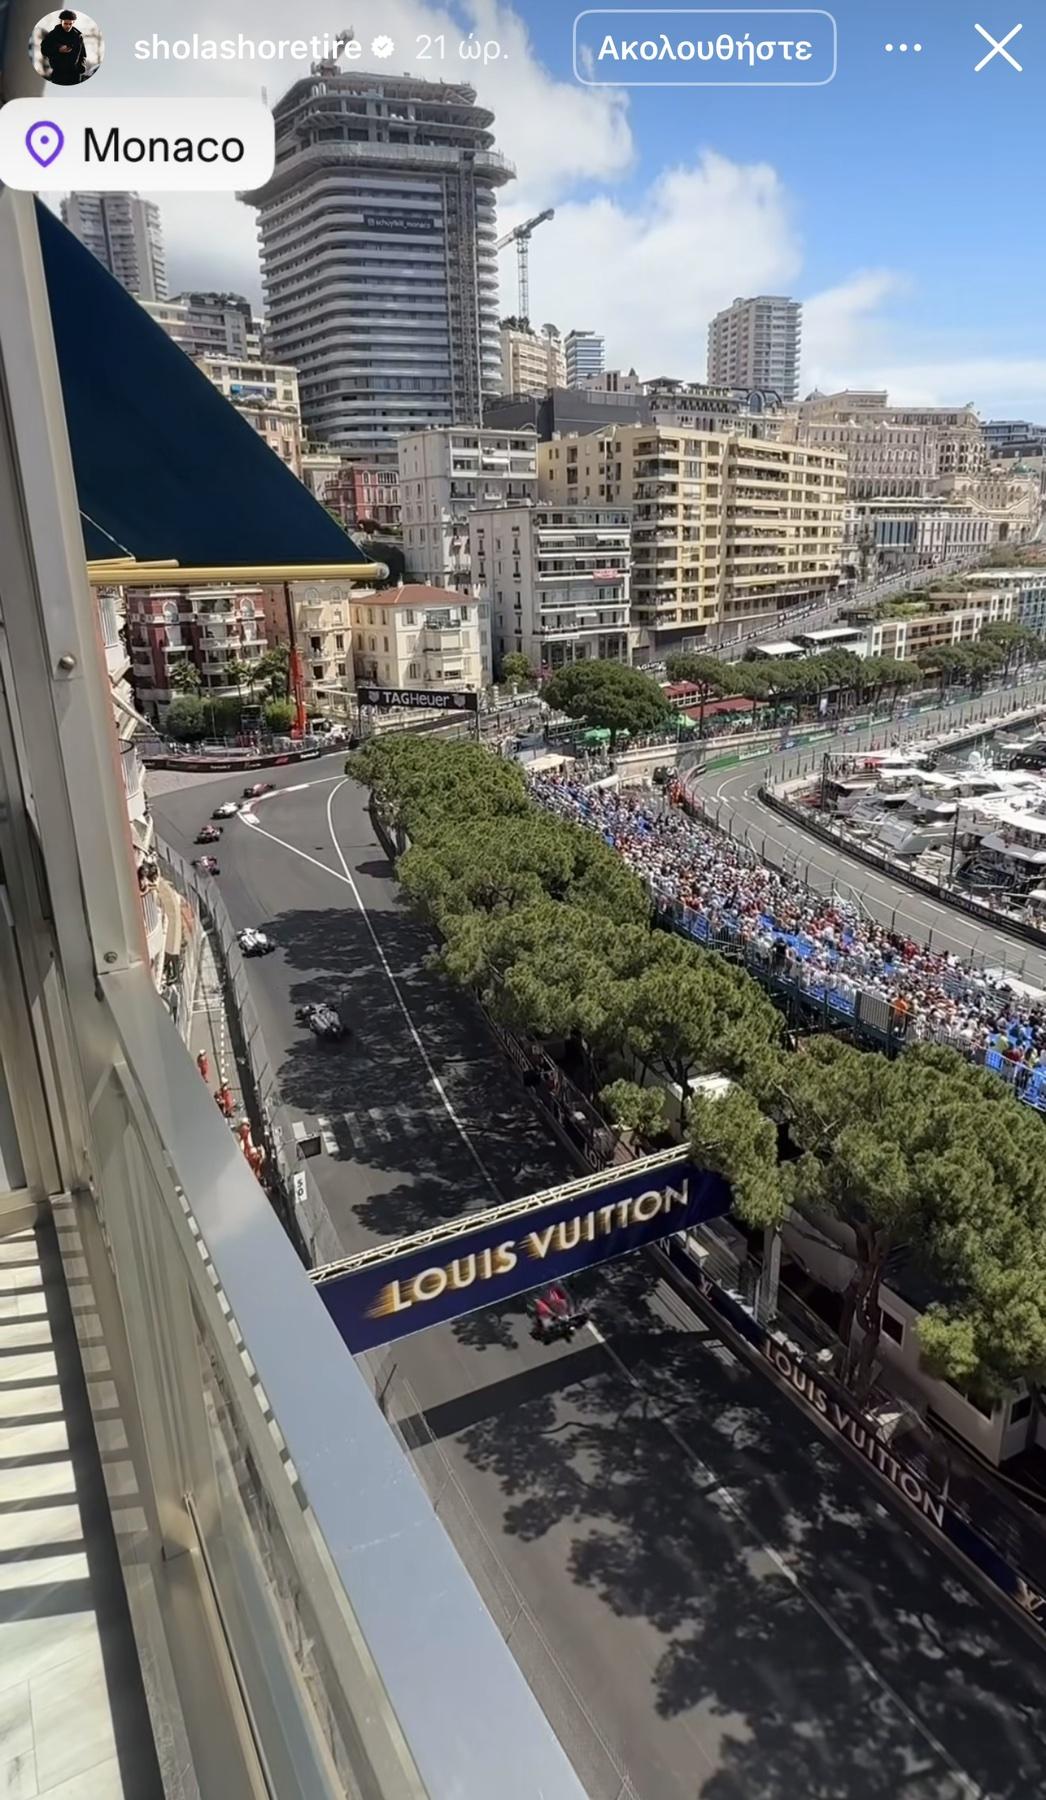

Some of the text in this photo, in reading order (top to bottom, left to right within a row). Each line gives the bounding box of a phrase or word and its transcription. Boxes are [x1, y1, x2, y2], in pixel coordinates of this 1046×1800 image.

[387, 1178, 690, 1314] LOUIS VUITTON
[765, 1339, 945, 1528] LOUIS VUITTON
